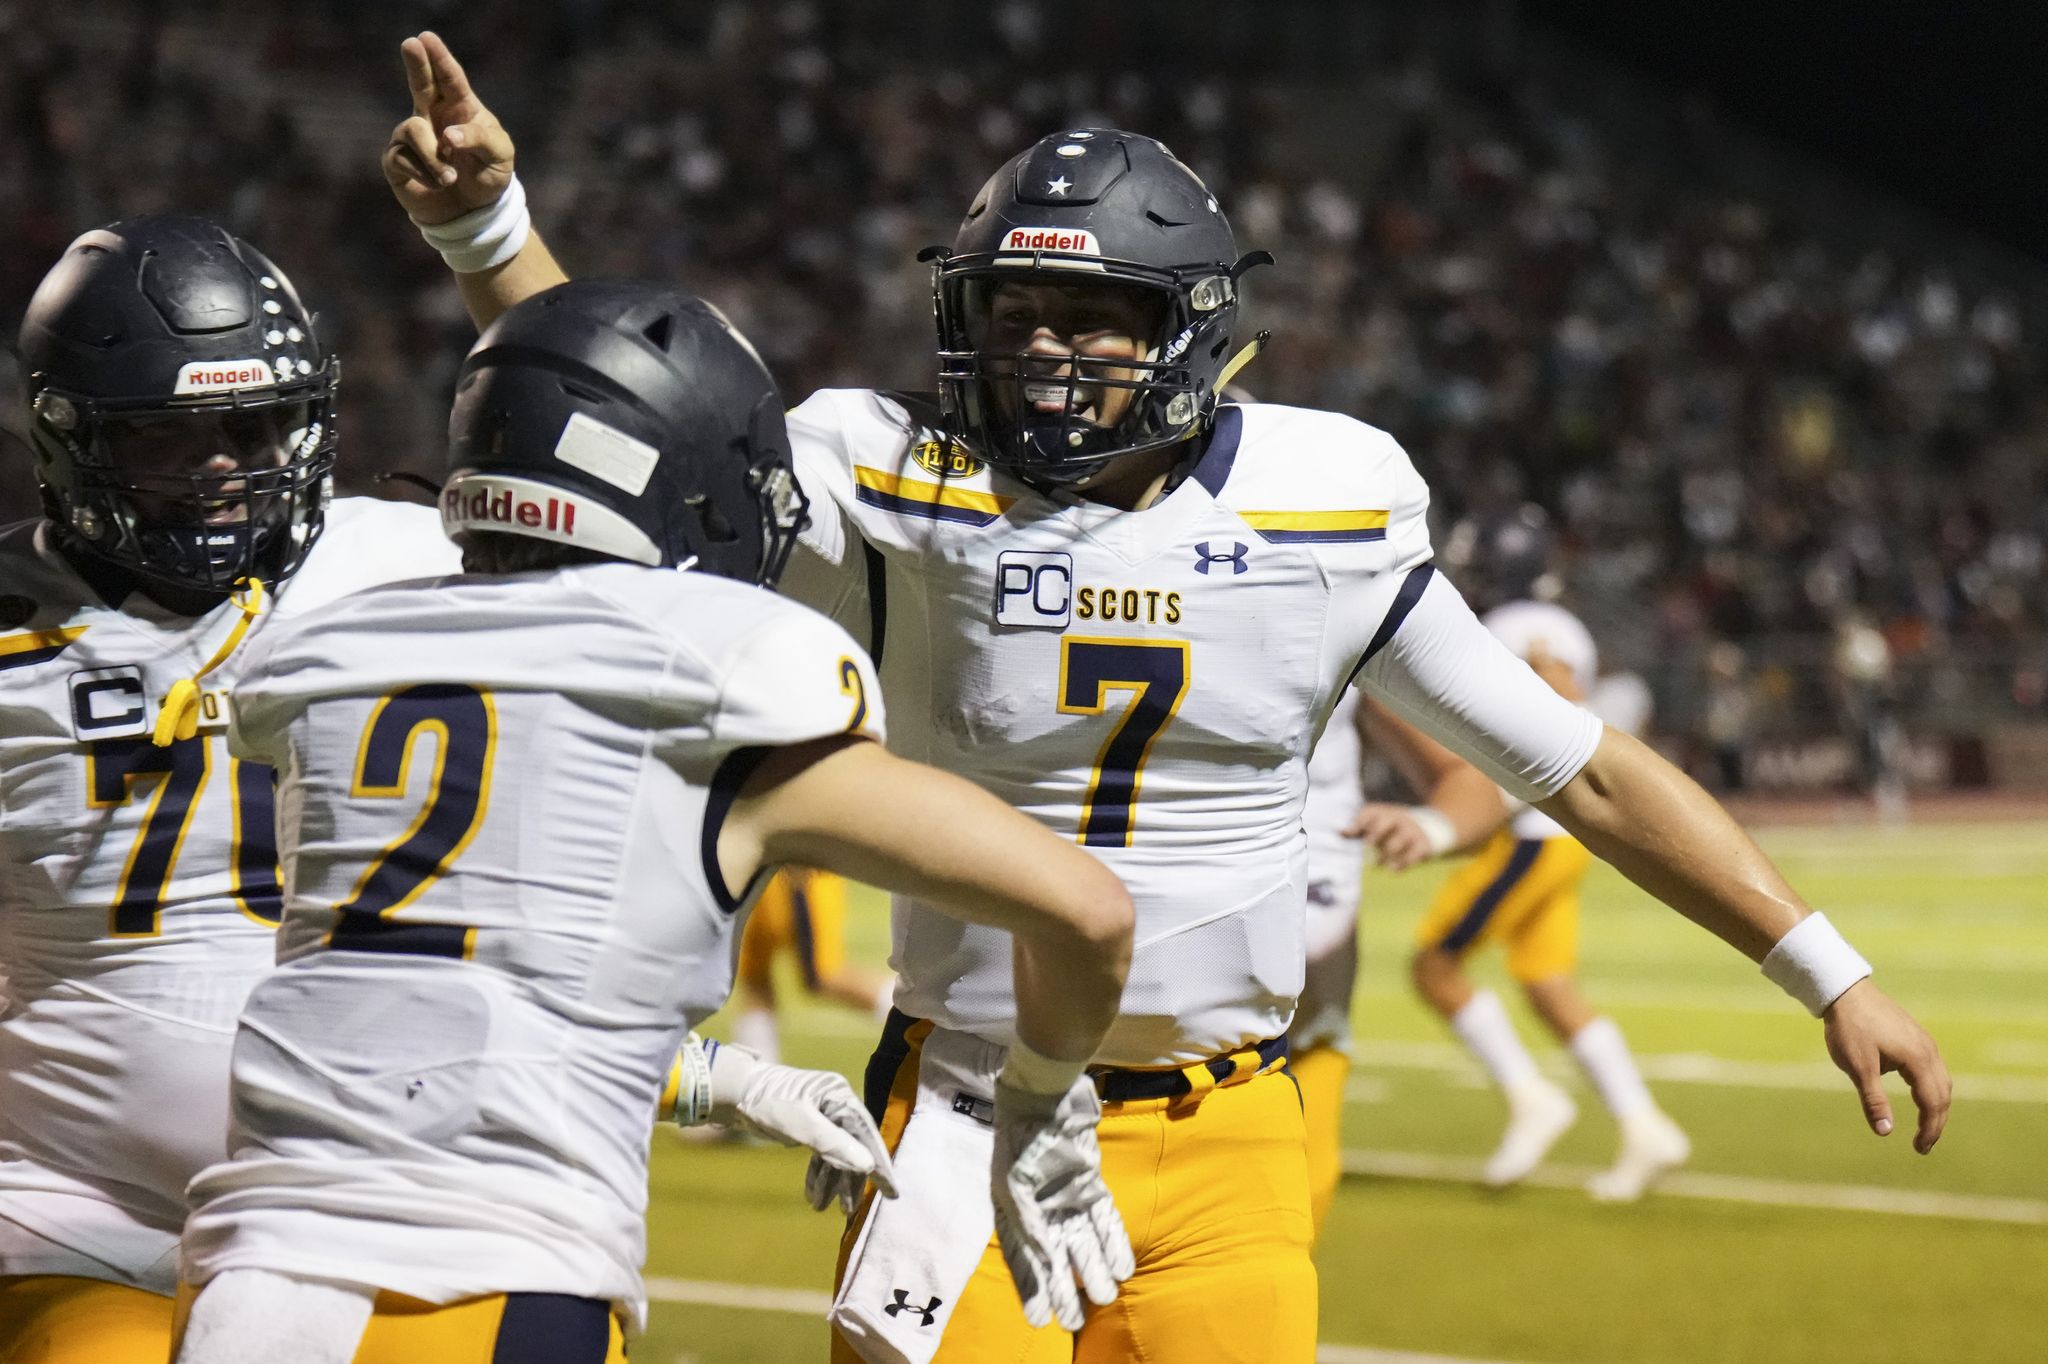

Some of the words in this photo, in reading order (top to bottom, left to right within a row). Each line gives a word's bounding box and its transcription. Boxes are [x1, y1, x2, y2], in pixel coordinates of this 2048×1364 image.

[1010, 231, 1086, 251] Riddell
[189, 367, 262, 385] Riddell
[444, 485, 576, 536] Riddell
[999, 563, 1070, 616] PC
[1076, 585, 1181, 625] SCOTS
[74, 677, 144, 730] C
[838, 655, 870, 733] 2
[1056, 634, 1191, 848] 7
[321, 682, 497, 961] 2
